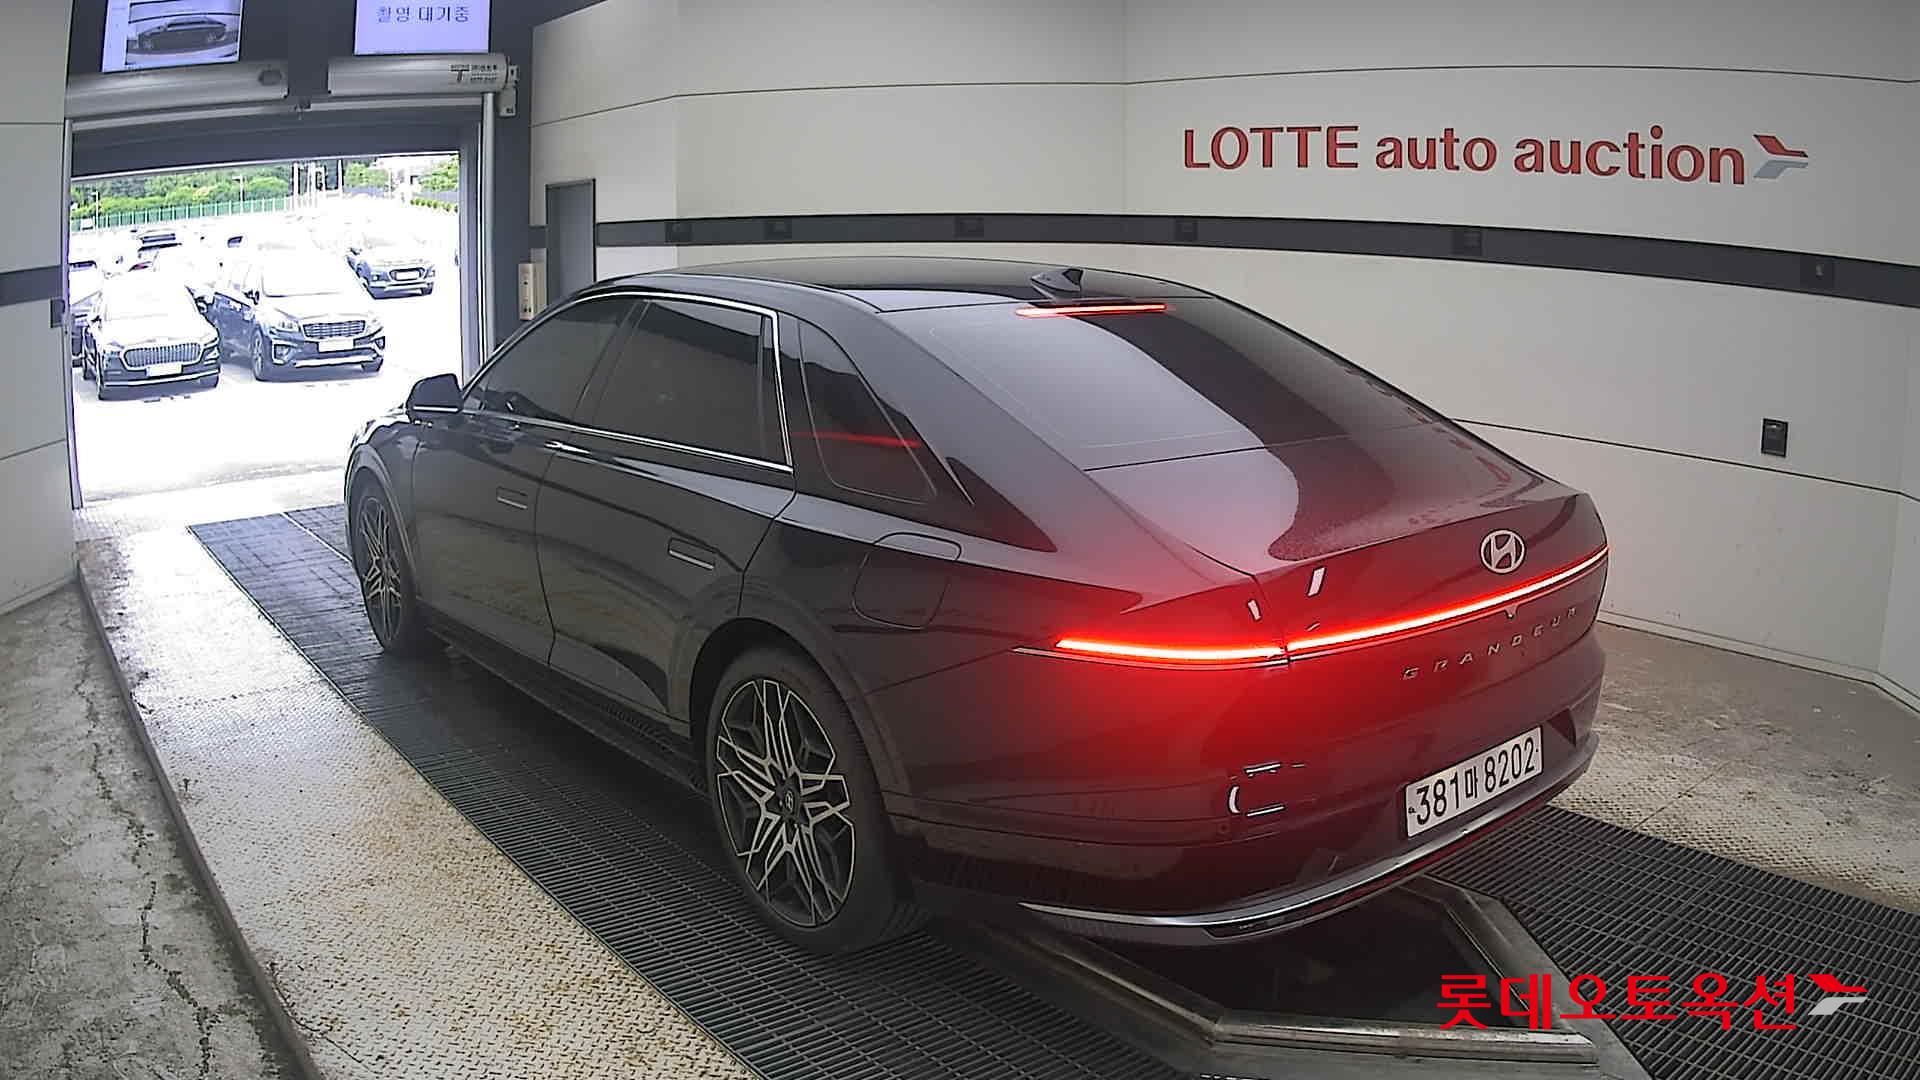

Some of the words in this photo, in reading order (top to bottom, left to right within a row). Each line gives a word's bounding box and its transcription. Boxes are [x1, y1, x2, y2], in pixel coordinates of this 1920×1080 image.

[418, 6, 470, 22] 대기중
[1184, 126, 1359, 170] LOTTE
[1375, 128, 1497, 171] auto
[1513, 125, 1746, 185] auction
[1402, 607, 1577, 680] GRANDEUR
